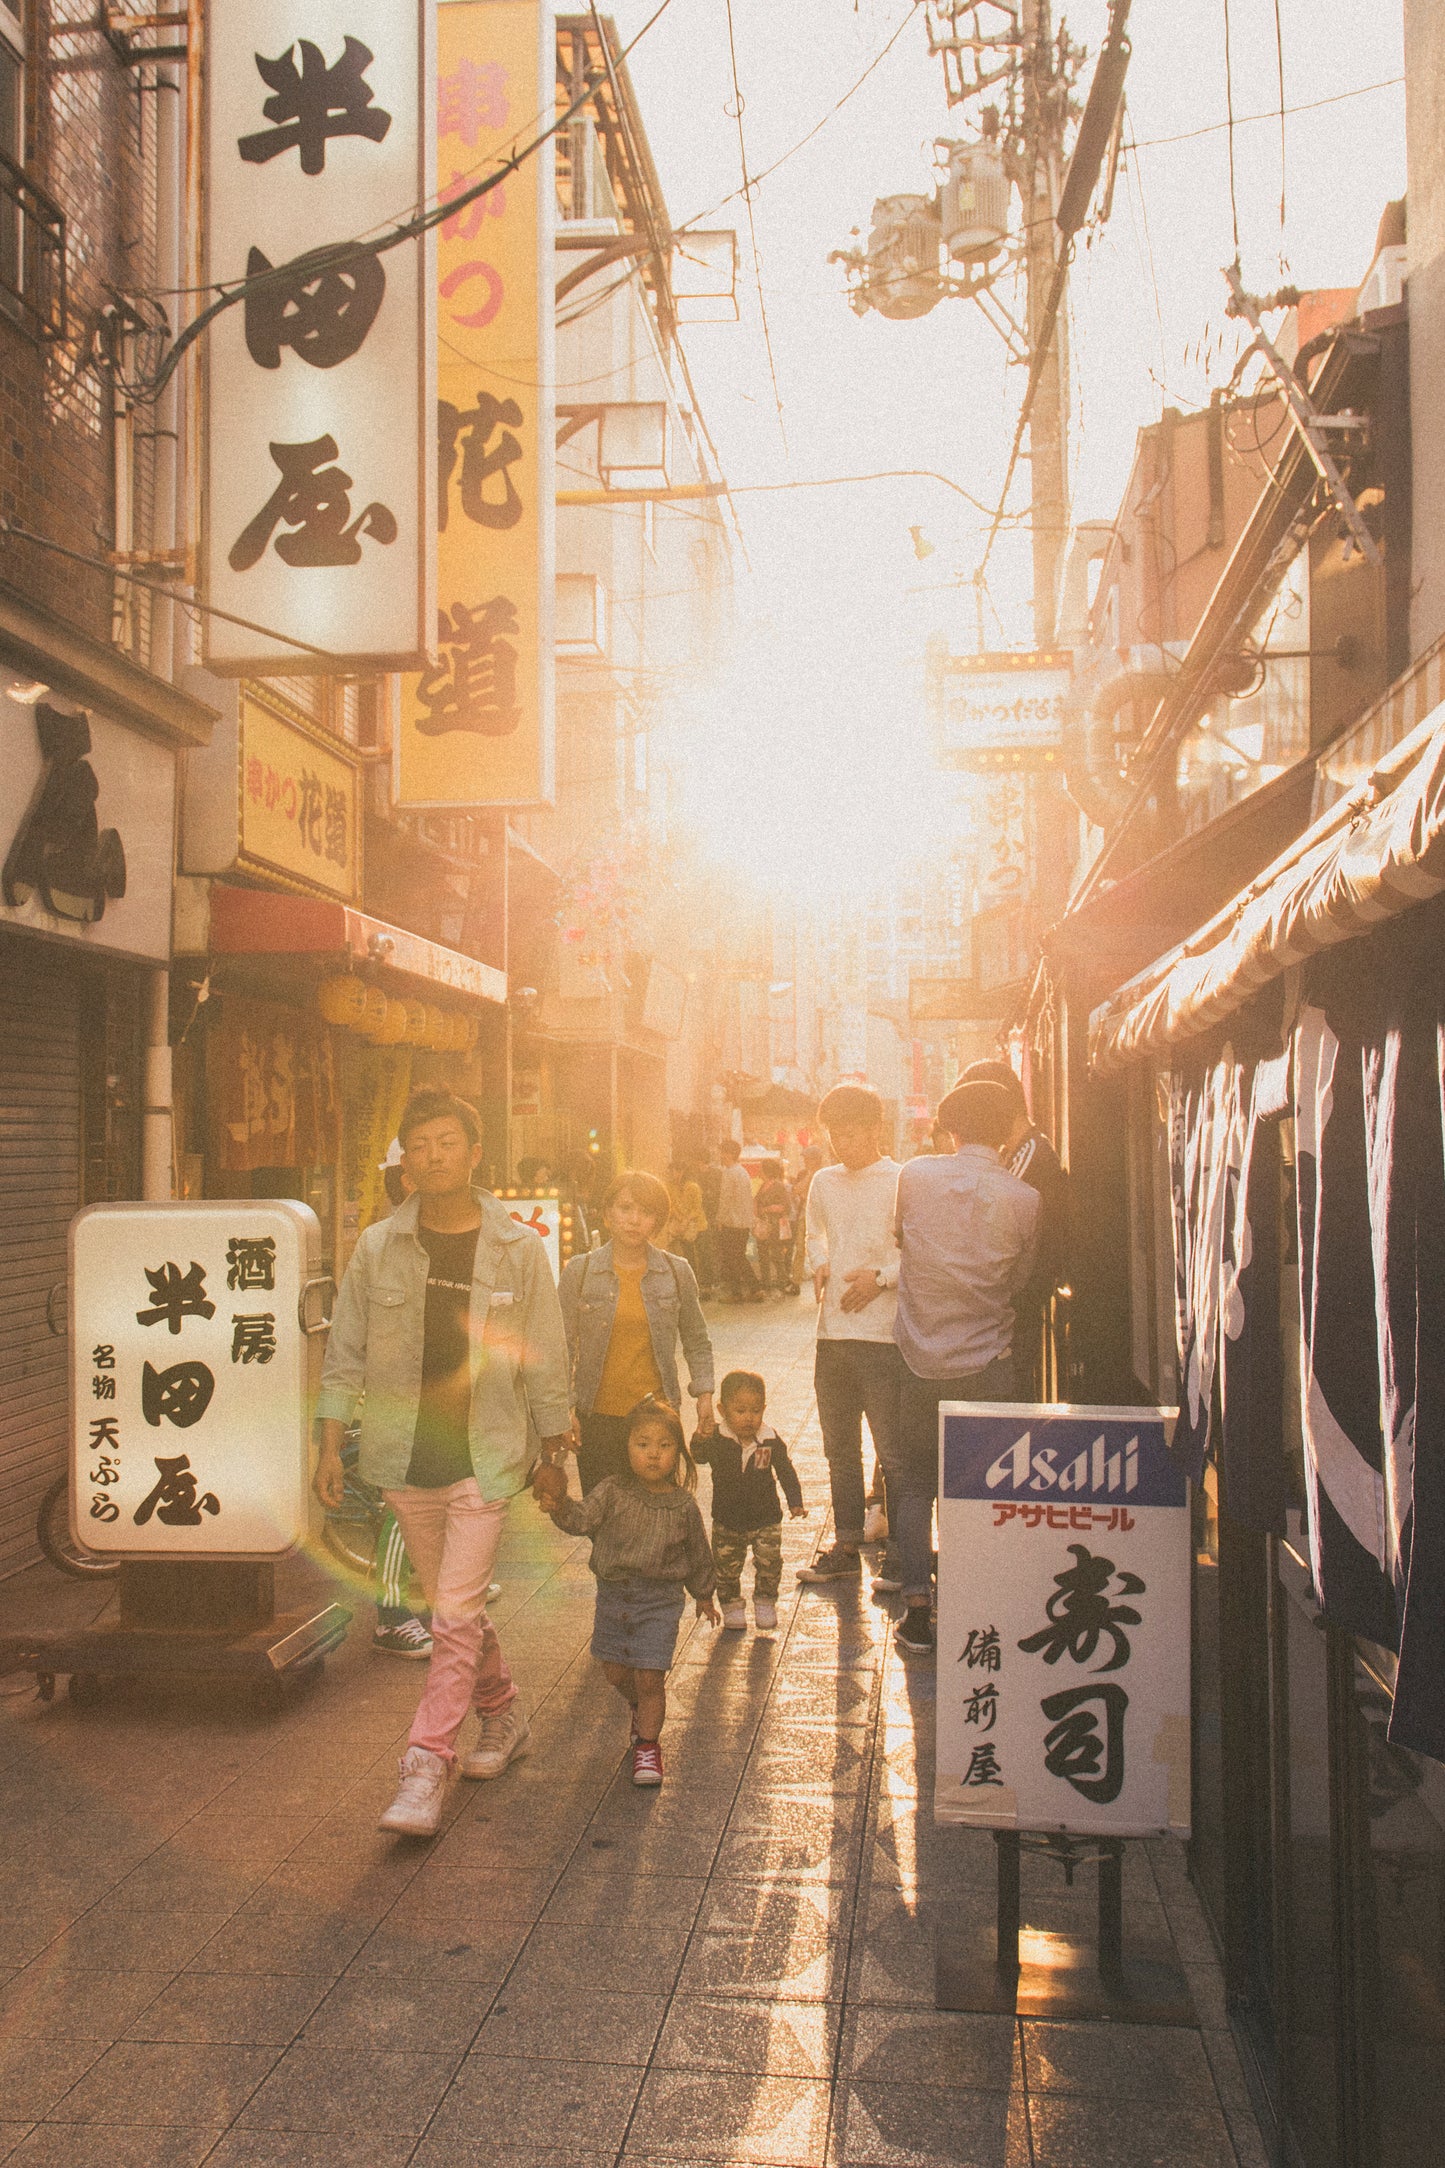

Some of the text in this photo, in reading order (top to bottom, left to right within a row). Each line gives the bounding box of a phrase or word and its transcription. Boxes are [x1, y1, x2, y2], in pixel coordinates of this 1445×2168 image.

[228, 35, 398, 573] 半田屋
[248, 756, 348, 868] 串かつ 花道
[226, 1236, 277, 1364] 酒房
[89, 1343, 121, 1523] 名物 天ぷら
[133, 1261, 221, 1526] 半田屋
[985, 1431, 1139, 1495] Asahi
[992, 1503, 1136, 1532] アサヒビール
[957, 1623, 1004, 1788] 備前屋
[1017, 1543, 1147, 1805] 寿司
